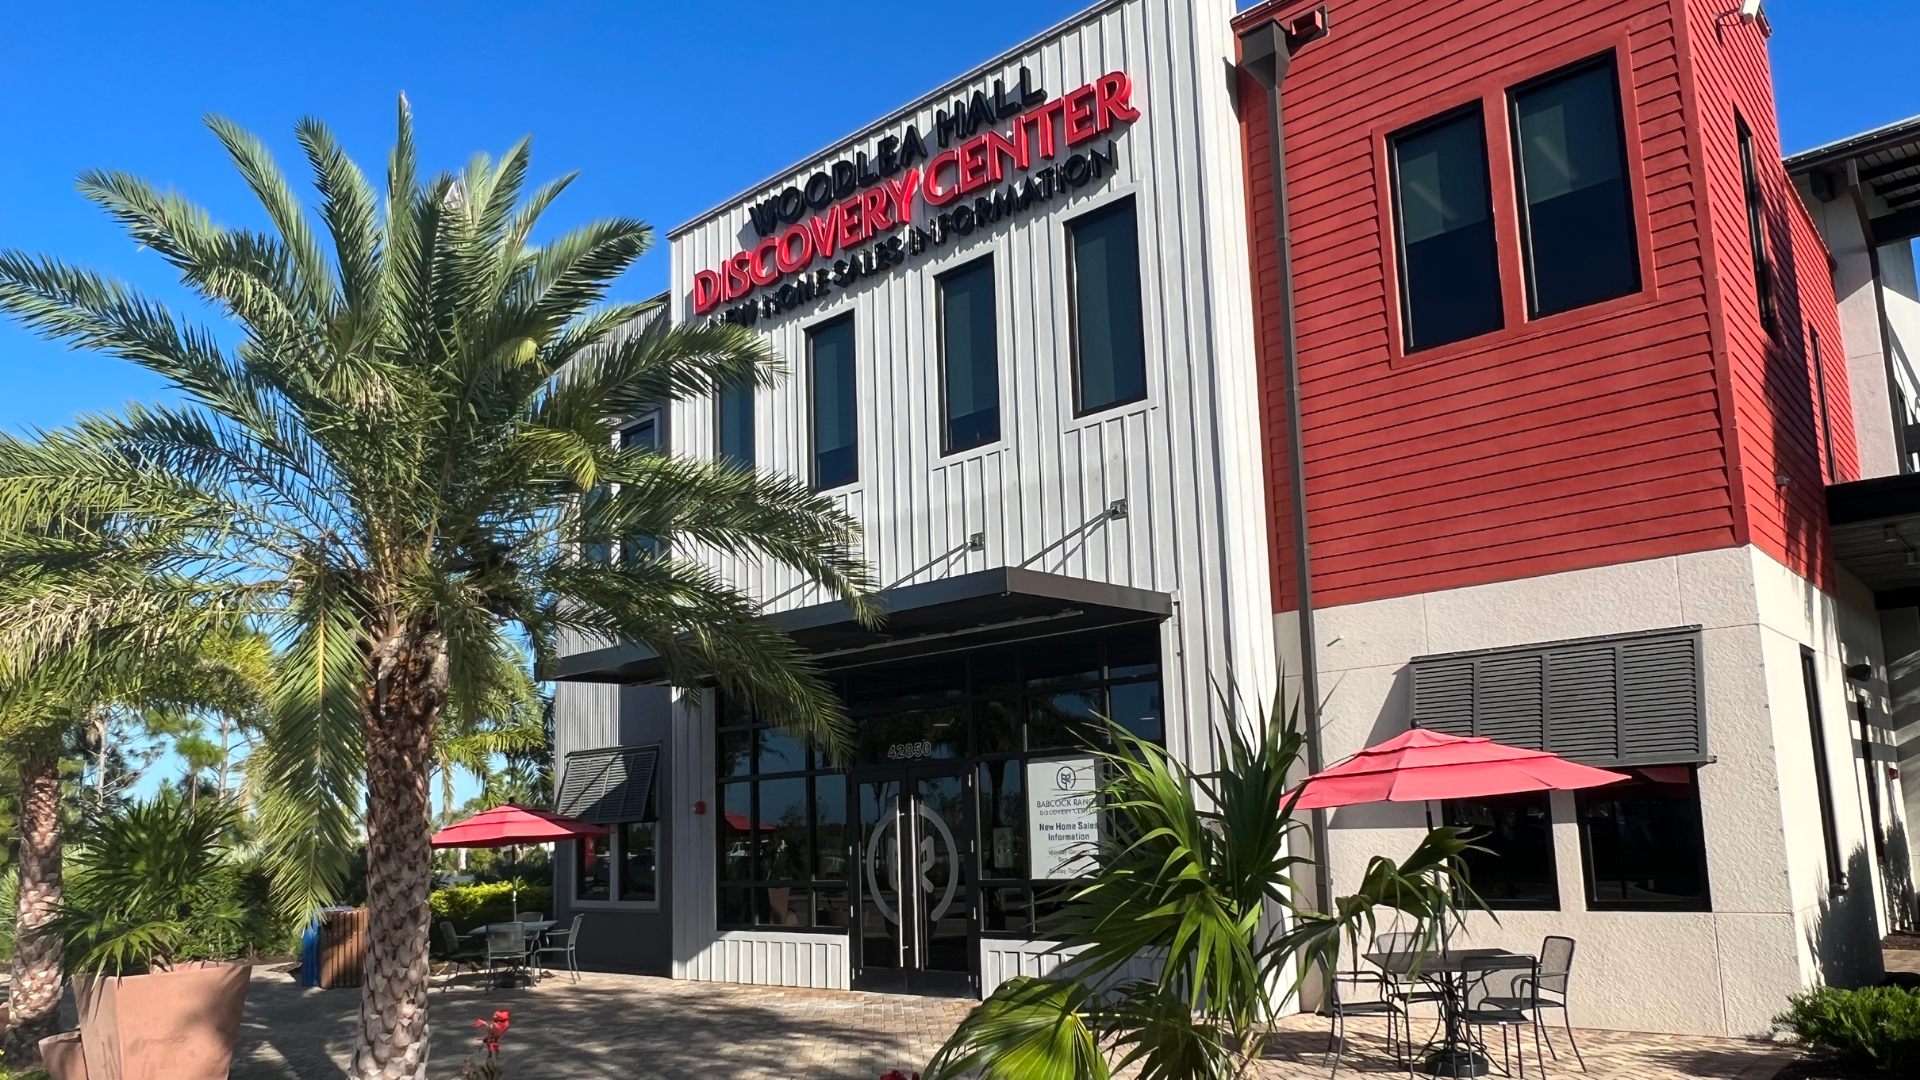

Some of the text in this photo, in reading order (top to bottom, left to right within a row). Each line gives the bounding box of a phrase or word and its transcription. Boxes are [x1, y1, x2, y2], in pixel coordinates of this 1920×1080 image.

[749, 66, 1048, 237] WOODLEA HALL
[694, 70, 1141, 315] DISCOVERY CENTER
[761, 268, 832, 319] HOME
[833, 235, 905, 288] SALES
[908, 139, 1120, 256] INFORMATION
[887, 741, 932, 760] 42850
[1036, 799, 1072, 808] BABCOCK
[1039, 821, 1098, 831] New Home Sales
[1048, 832, 1090, 841] Information
